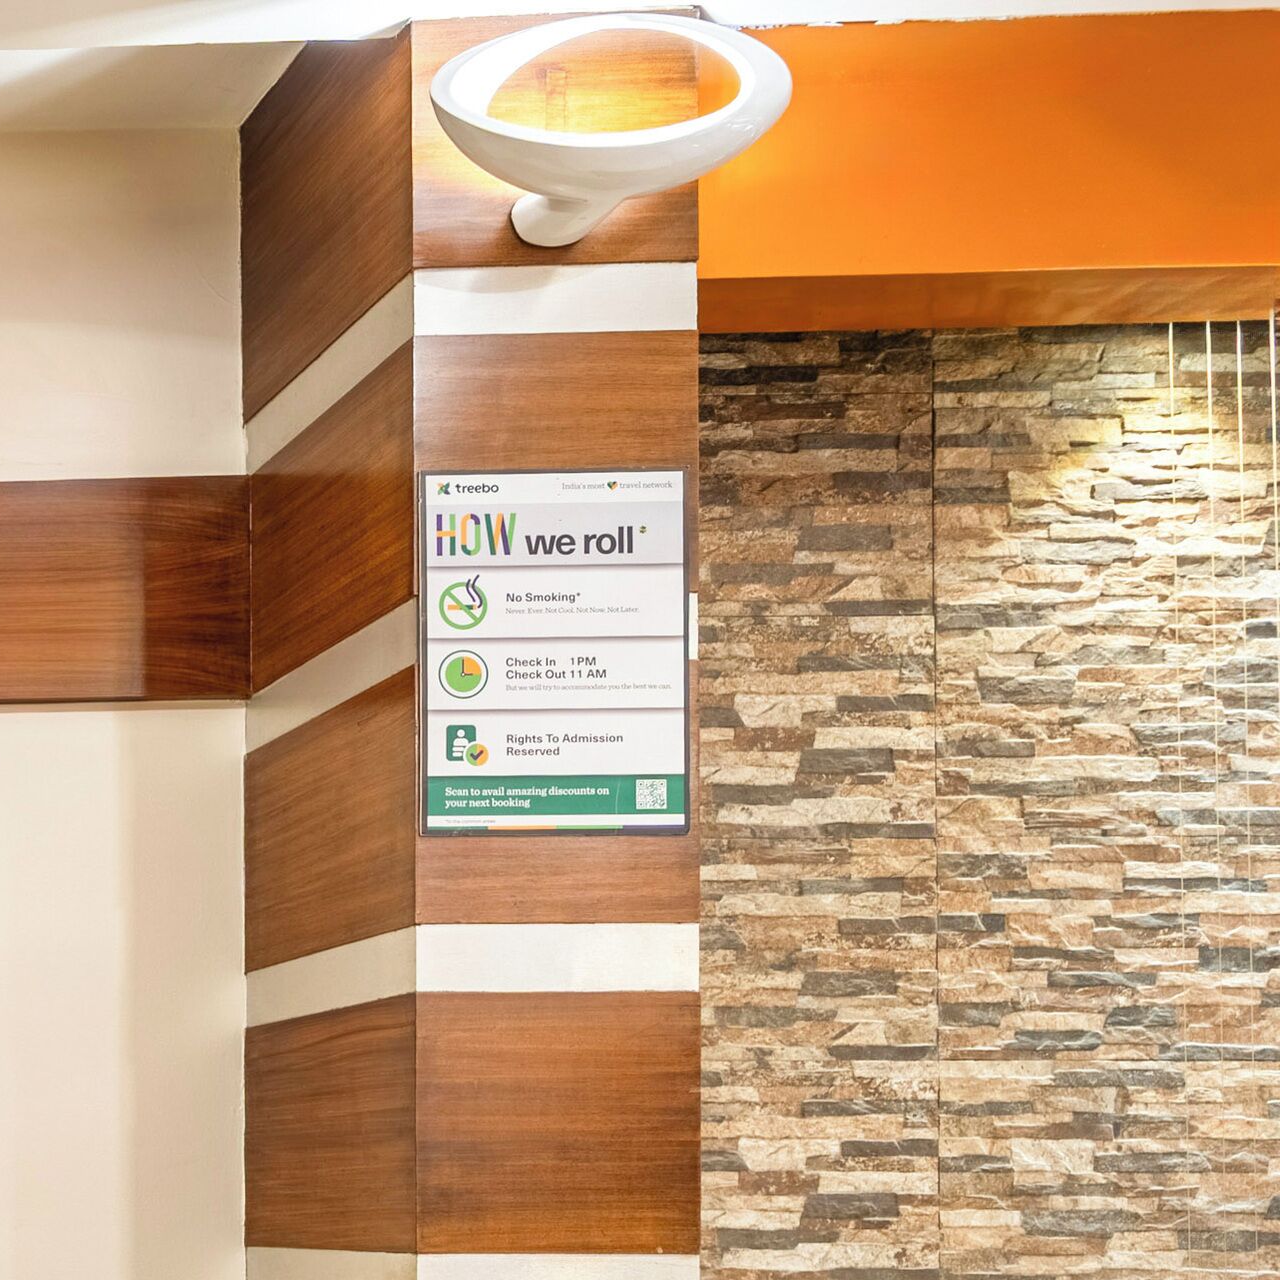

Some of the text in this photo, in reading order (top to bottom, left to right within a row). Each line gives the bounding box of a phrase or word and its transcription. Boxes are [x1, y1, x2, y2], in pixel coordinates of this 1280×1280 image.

[455, 483, 499, 493] treebo
[562, 482, 586, 490] India's
[619, 481, 641, 489] travel
[642, 481, 672, 489] network
[436, 512, 516, 556] HOW
[525, 534, 576, 556] we
[506, 593, 522, 602] No
[506, 658, 542, 667] Check
[545, 657, 556, 666] In
[506, 669, 607, 679] Check Out 11 AM
[506, 733, 624, 745] Rights To Admission
[506, 747, 560, 756] Reserved
[445, 787, 469, 796] Scan
[470, 787, 480, 796] to
[482, 787, 505, 796] avail
[506, 787, 547, 798] amazing
[548, 786, 596, 796] discounts
[445, 798, 530, 809] your next booking
